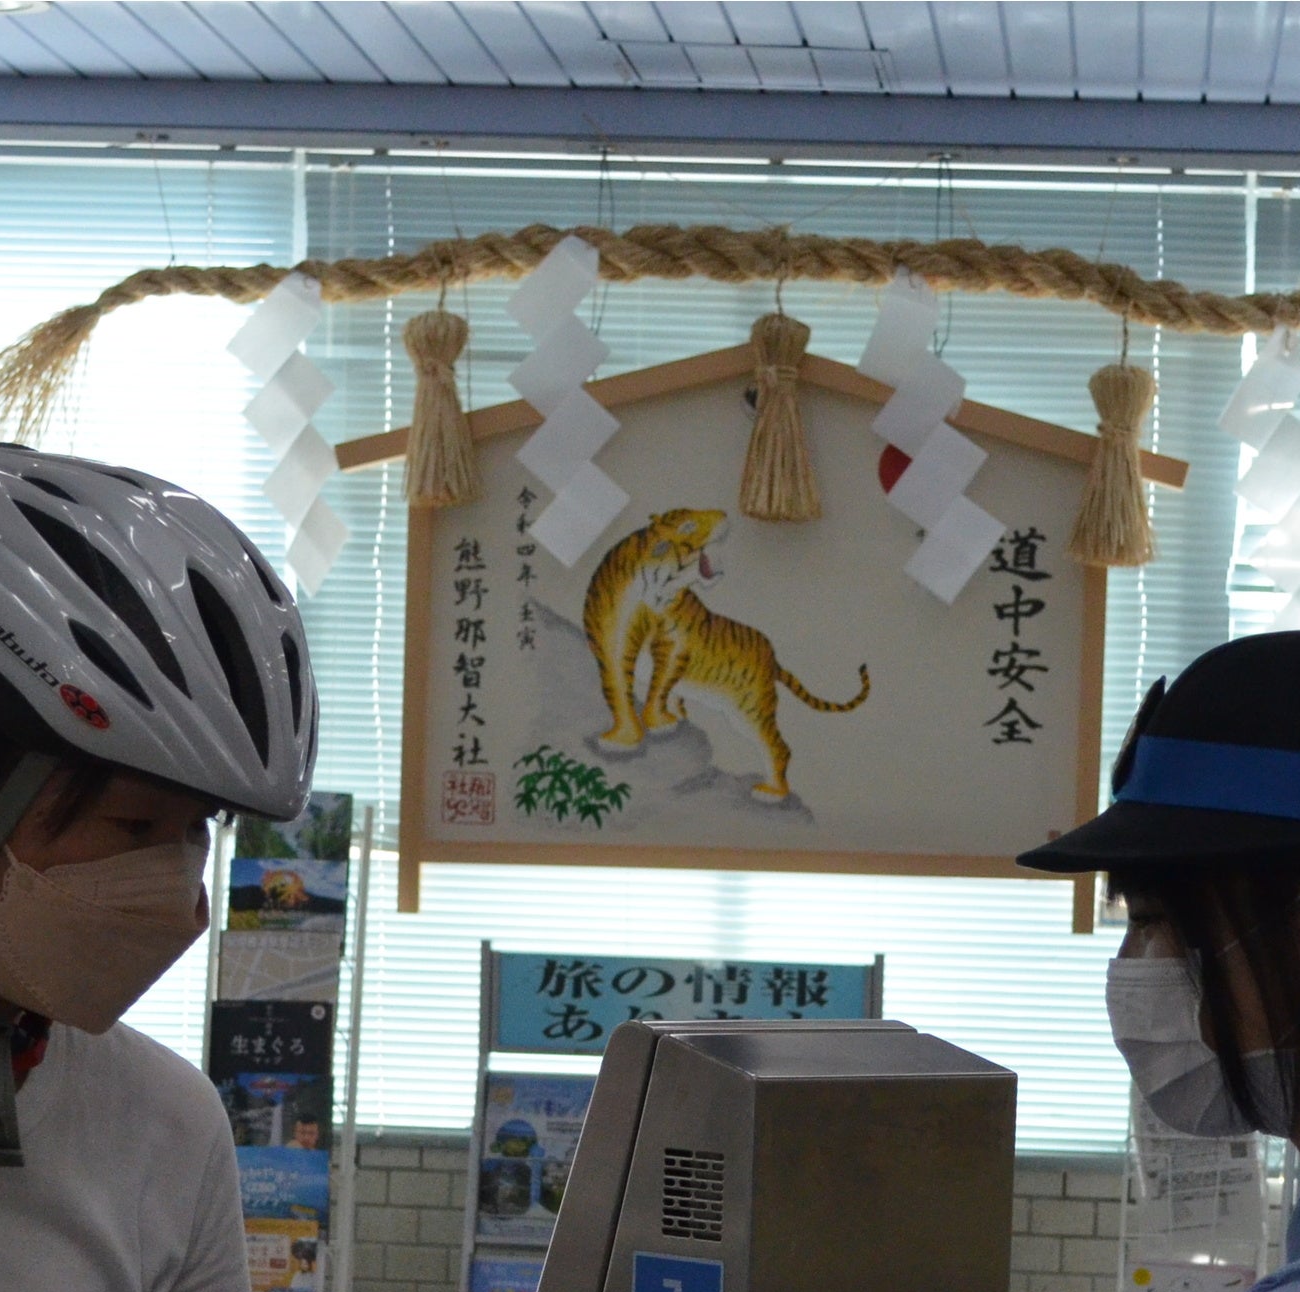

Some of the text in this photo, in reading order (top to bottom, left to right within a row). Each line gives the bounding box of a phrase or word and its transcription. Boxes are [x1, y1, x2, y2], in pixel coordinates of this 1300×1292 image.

[452, 537, 489, 767] 熊野那智大社
[982, 527, 1053, 746] 道中安全
[230, 1034, 305, 1056] 生まぐろ
[537, 958, 831, 1008] 旅の情報
